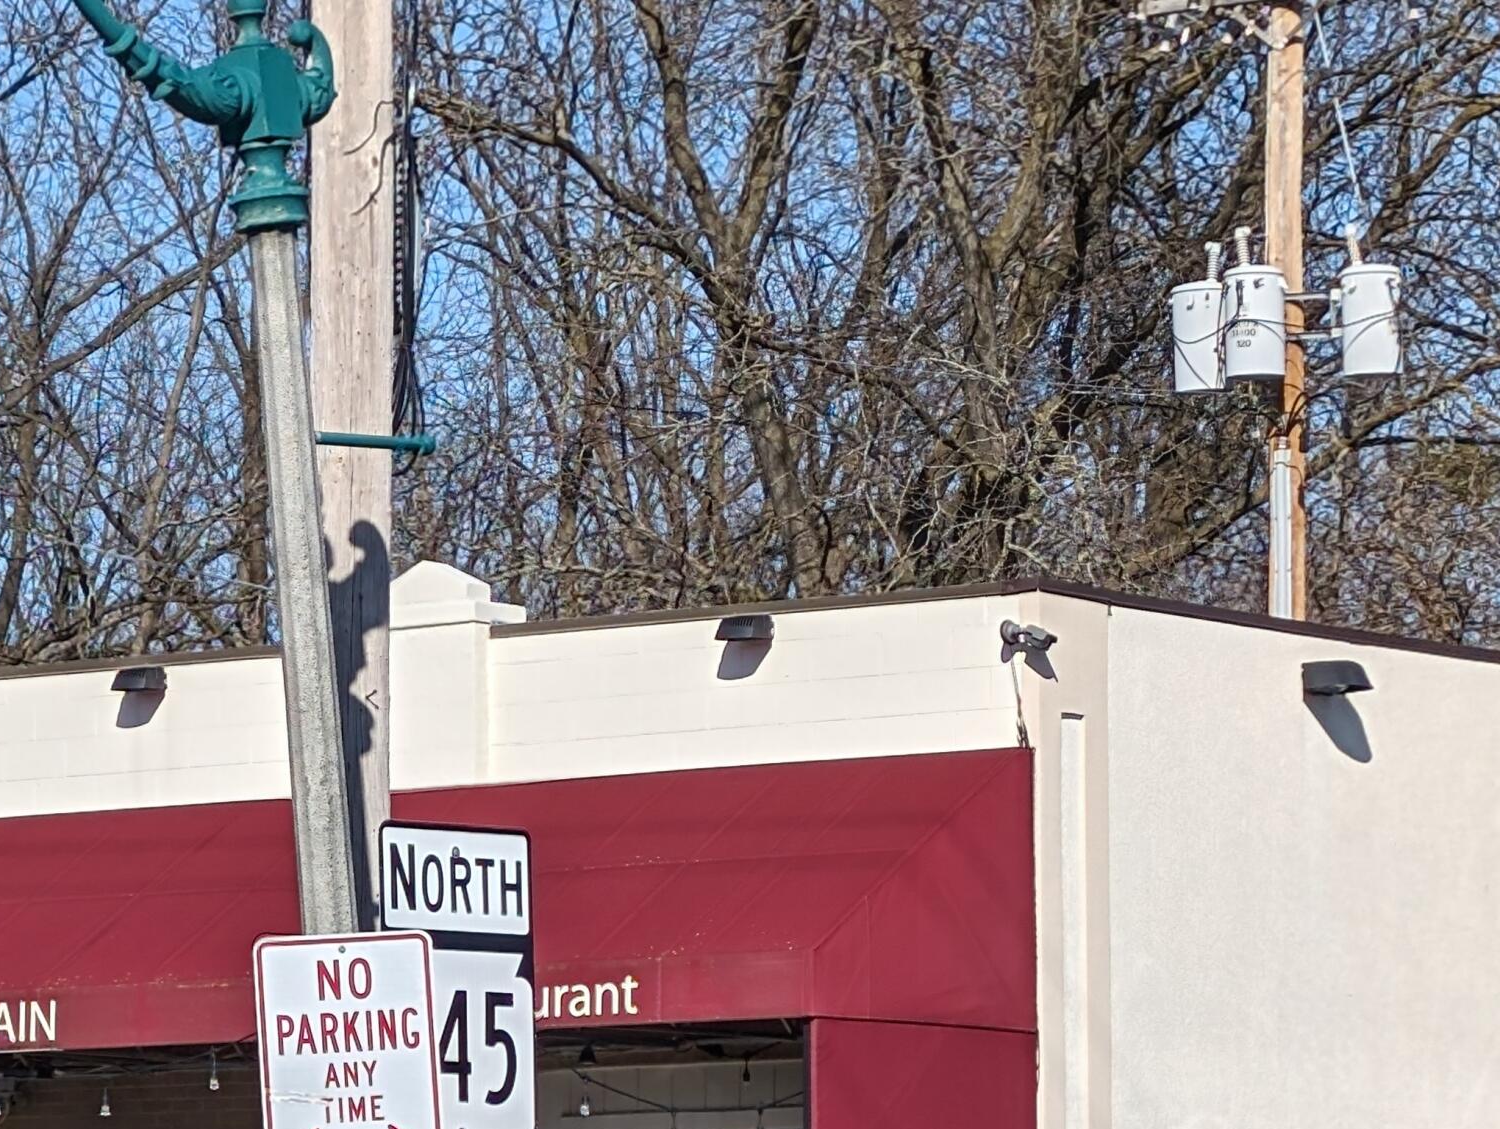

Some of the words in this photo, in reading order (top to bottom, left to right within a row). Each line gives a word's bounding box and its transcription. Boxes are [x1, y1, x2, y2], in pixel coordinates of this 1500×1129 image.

[389, 843, 523, 917] NORTH
[316, 957, 373, 1002] NO
[276, 1007, 421, 1056] PARKING
[439, 989, 518, 1106] 45
[324, 1060, 378, 1089] ANY
[323, 1094, 386, 1124] TIME
